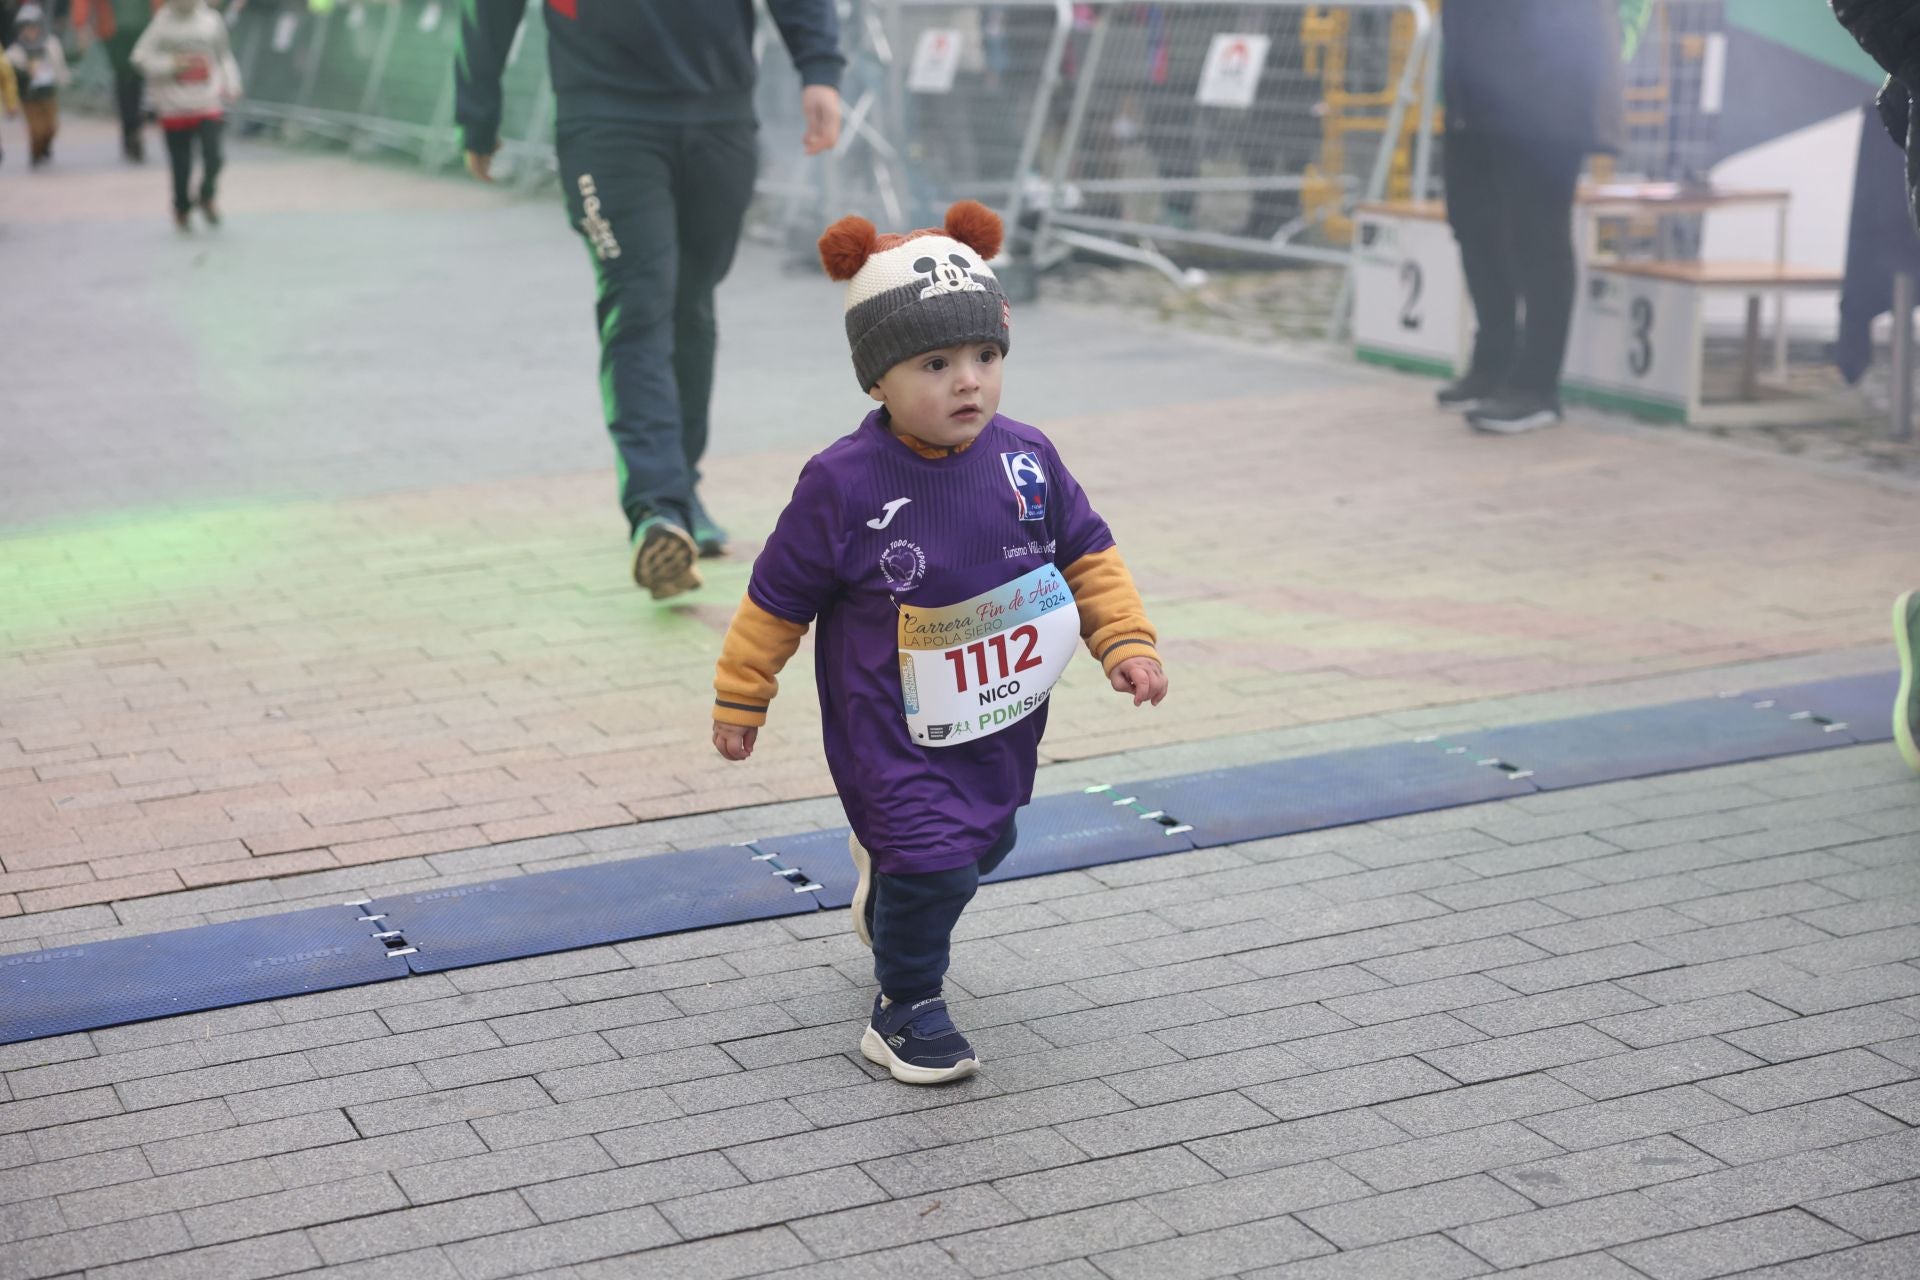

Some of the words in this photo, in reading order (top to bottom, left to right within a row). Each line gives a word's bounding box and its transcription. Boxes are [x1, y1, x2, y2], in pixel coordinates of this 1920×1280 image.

[1401, 259, 1422, 330] 2
[1629, 297, 1653, 377] 3
[890, 539, 908, 550] TODO
[912, 546, 926, 579] DEPORTE
[1002, 544, 1028, 559] Turismo
[904, 616, 974, 634] Carrera
[976, 601, 1005, 621] Fin
[1009, 588, 1025, 611] de
[1028, 578, 1060, 604] Año
[1038, 592, 1066, 612] 2024
[903, 635, 920, 647] LA
[924, 632, 962, 647] POLA
[965, 618, 1003, 637] SIERO
[945, 624, 1043, 693] 1112
[978, 680, 1021, 706] NICO
